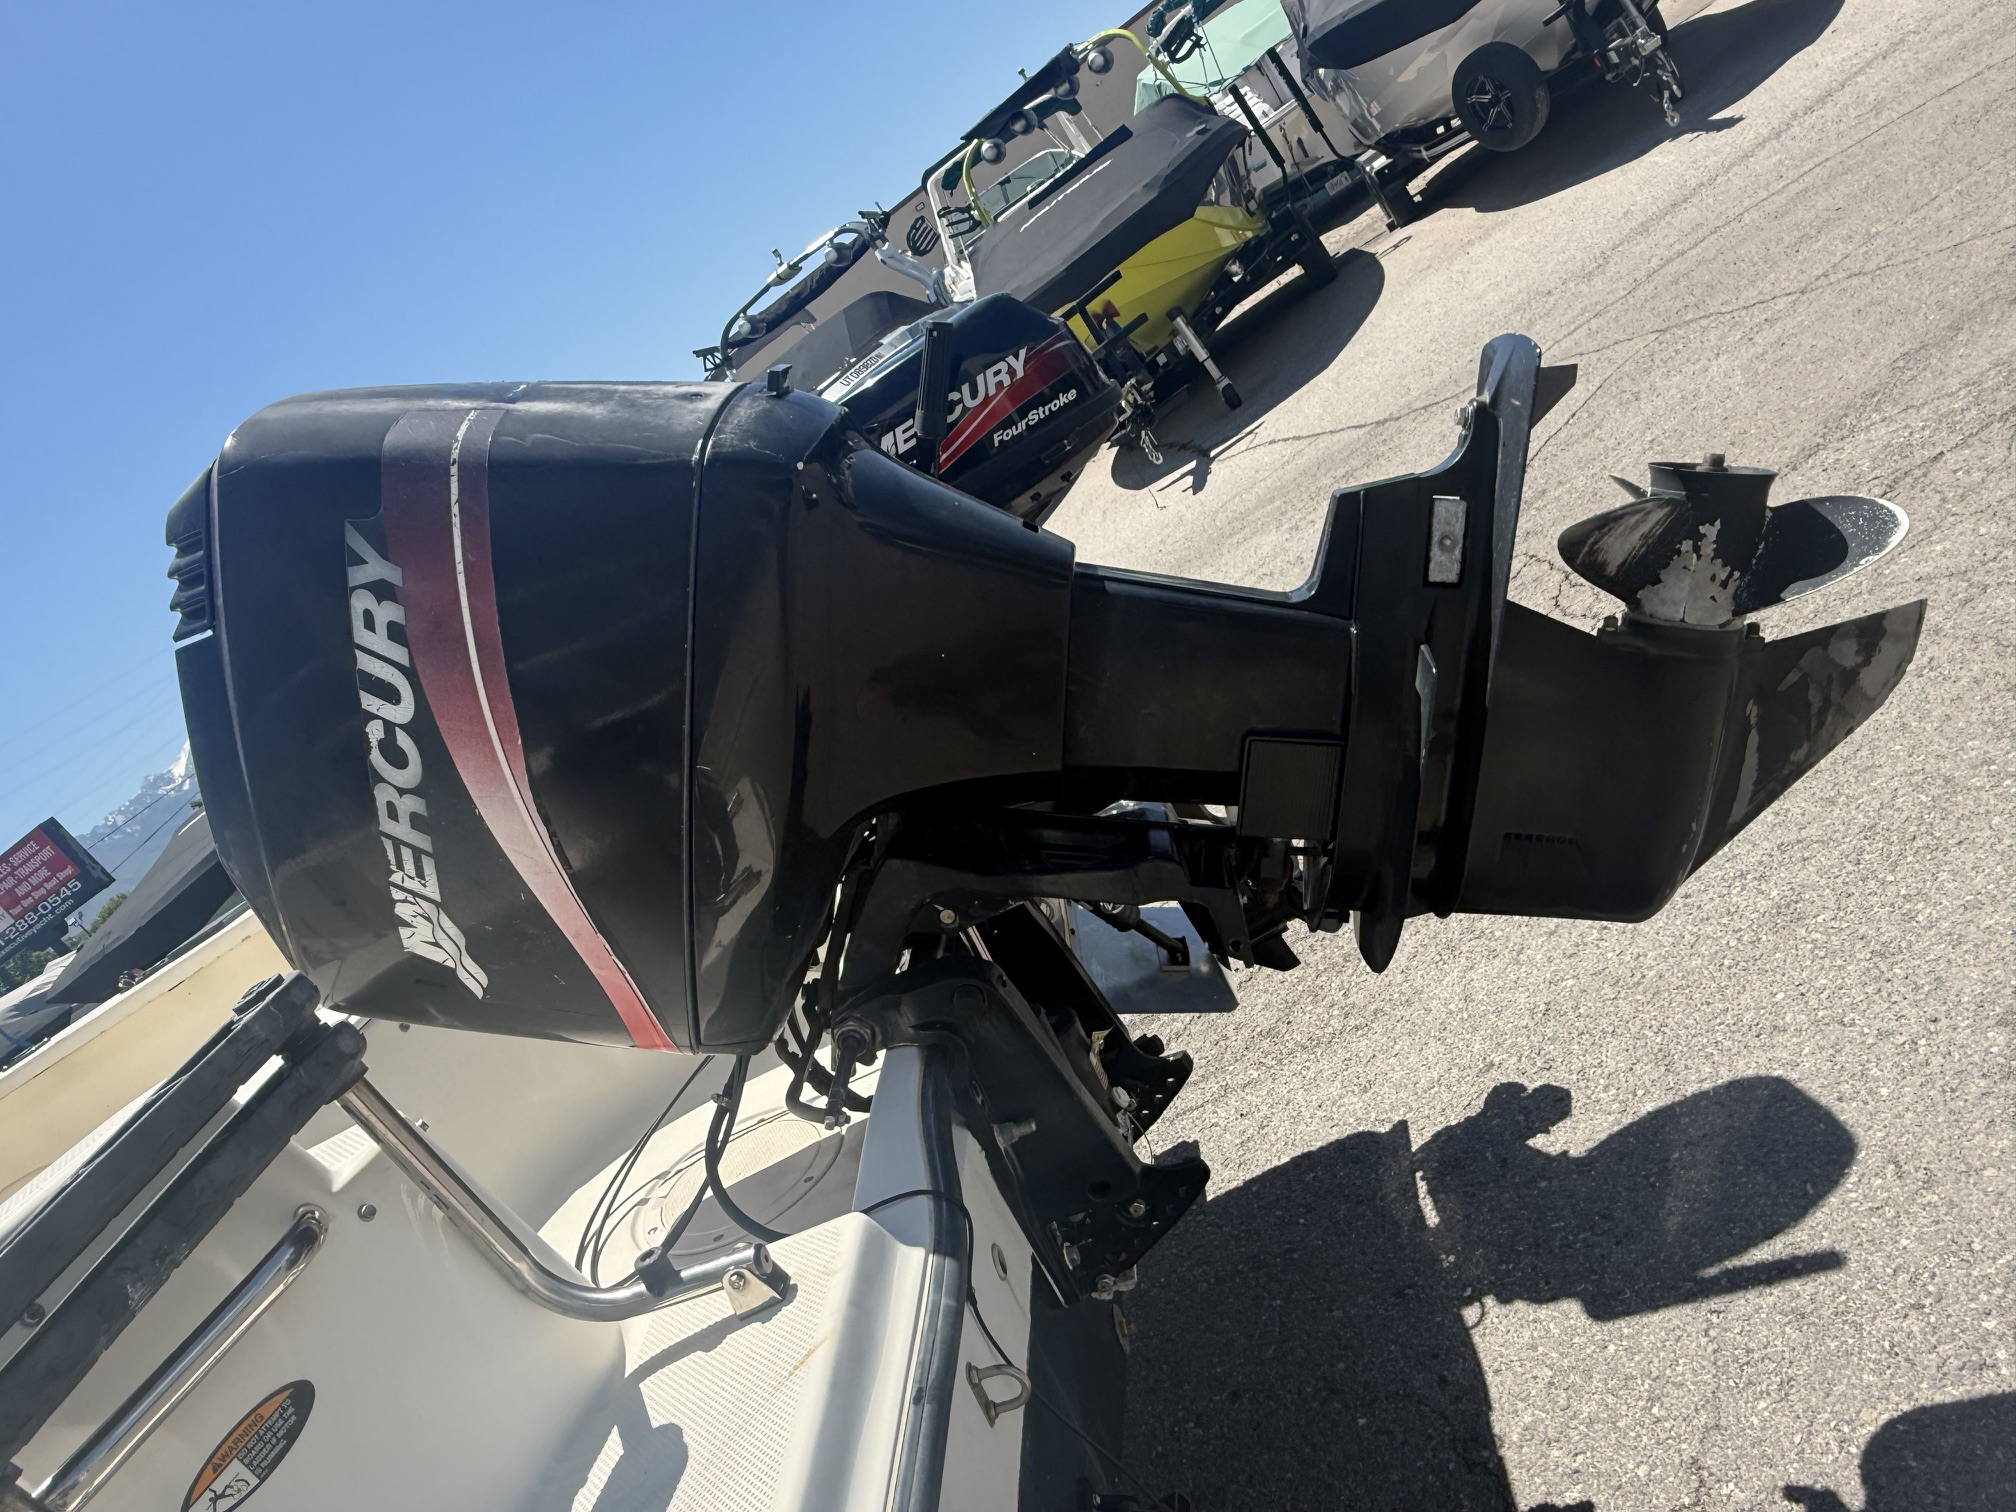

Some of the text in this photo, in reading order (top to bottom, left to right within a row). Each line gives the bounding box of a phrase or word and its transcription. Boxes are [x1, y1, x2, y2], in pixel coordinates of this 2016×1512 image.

[880, 346, 1027, 457] MECURY
[993, 388, 1077, 447] FourStroke
[345, 519, 489, 1000] MERCURY
[9, 840, 40, 867] SERVICE
[14, 845, 55, 879] TRANSPORT
[15, 866, 51, 897] AND MORE
[218, 1413, 265, 1463] WARNING
